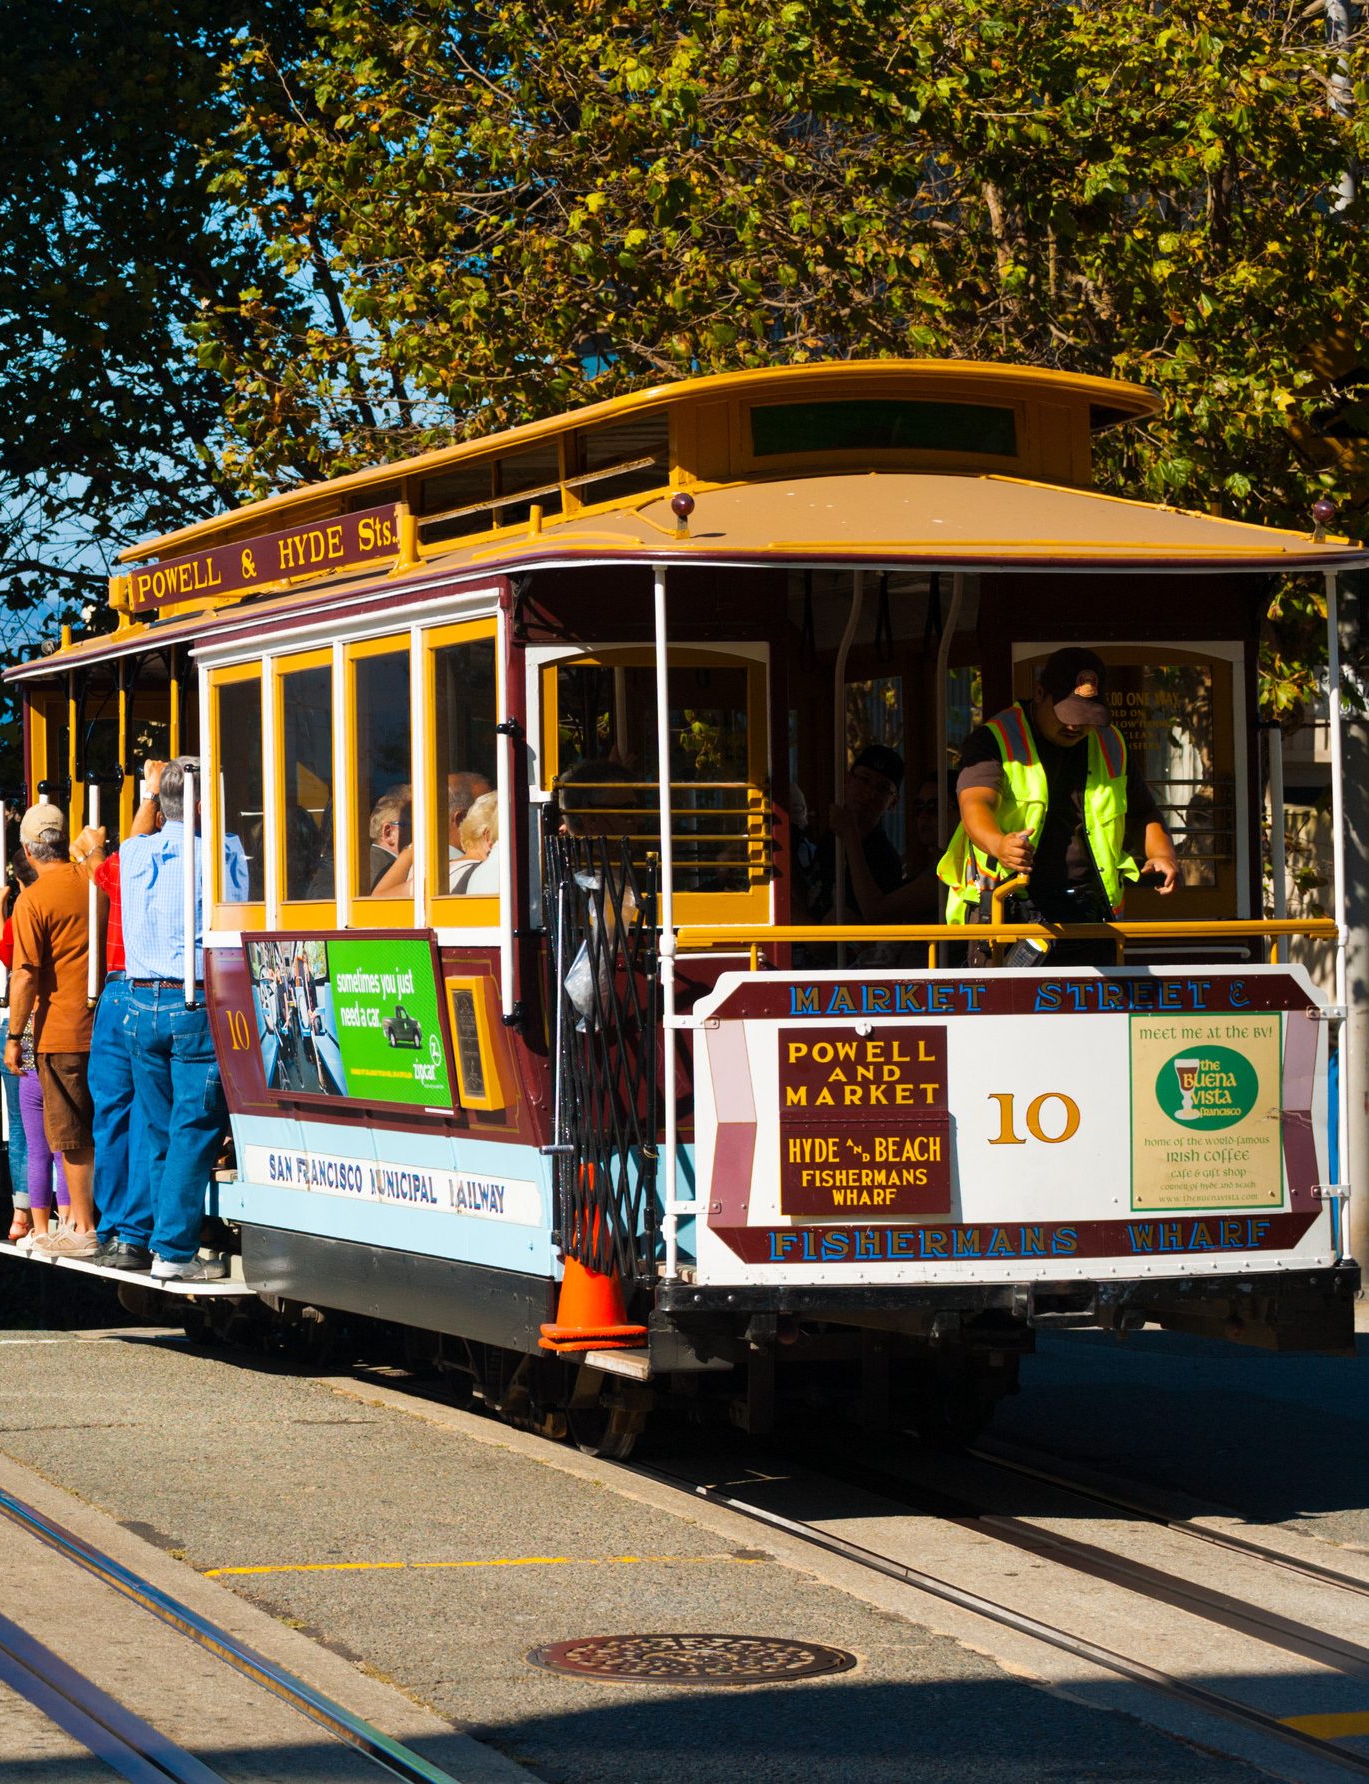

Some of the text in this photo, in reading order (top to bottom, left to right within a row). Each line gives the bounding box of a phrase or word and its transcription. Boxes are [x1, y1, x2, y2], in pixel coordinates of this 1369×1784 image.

[137, 517, 398, 602] POWELL & HYDE Sts.
[336, 967, 414, 1000] sometimes you just
[789, 983, 987, 1015] MARKET
[1035, 979, 1211, 1012] STREET
[340, 1001, 381, 1027] need a car.
[226, 1010, 250, 1050] 10
[787, 1041, 936, 1063] POWELL
[828, 1065, 901, 1082] AND
[785, 1083, 939, 1106] MARKET
[987, 1092, 1081, 1145] 10
[788, 1137, 941, 1163] HYDE AND BEACH
[269, 1154, 293, 1182] SAN
[297, 1158, 362, 1193] FRANCISCO
[802, 1168, 928, 1187] FISHERMANS
[832, 1189, 897, 1206] WHARF
[769, 1218, 1272, 1262] FISHERMANS WHARF
